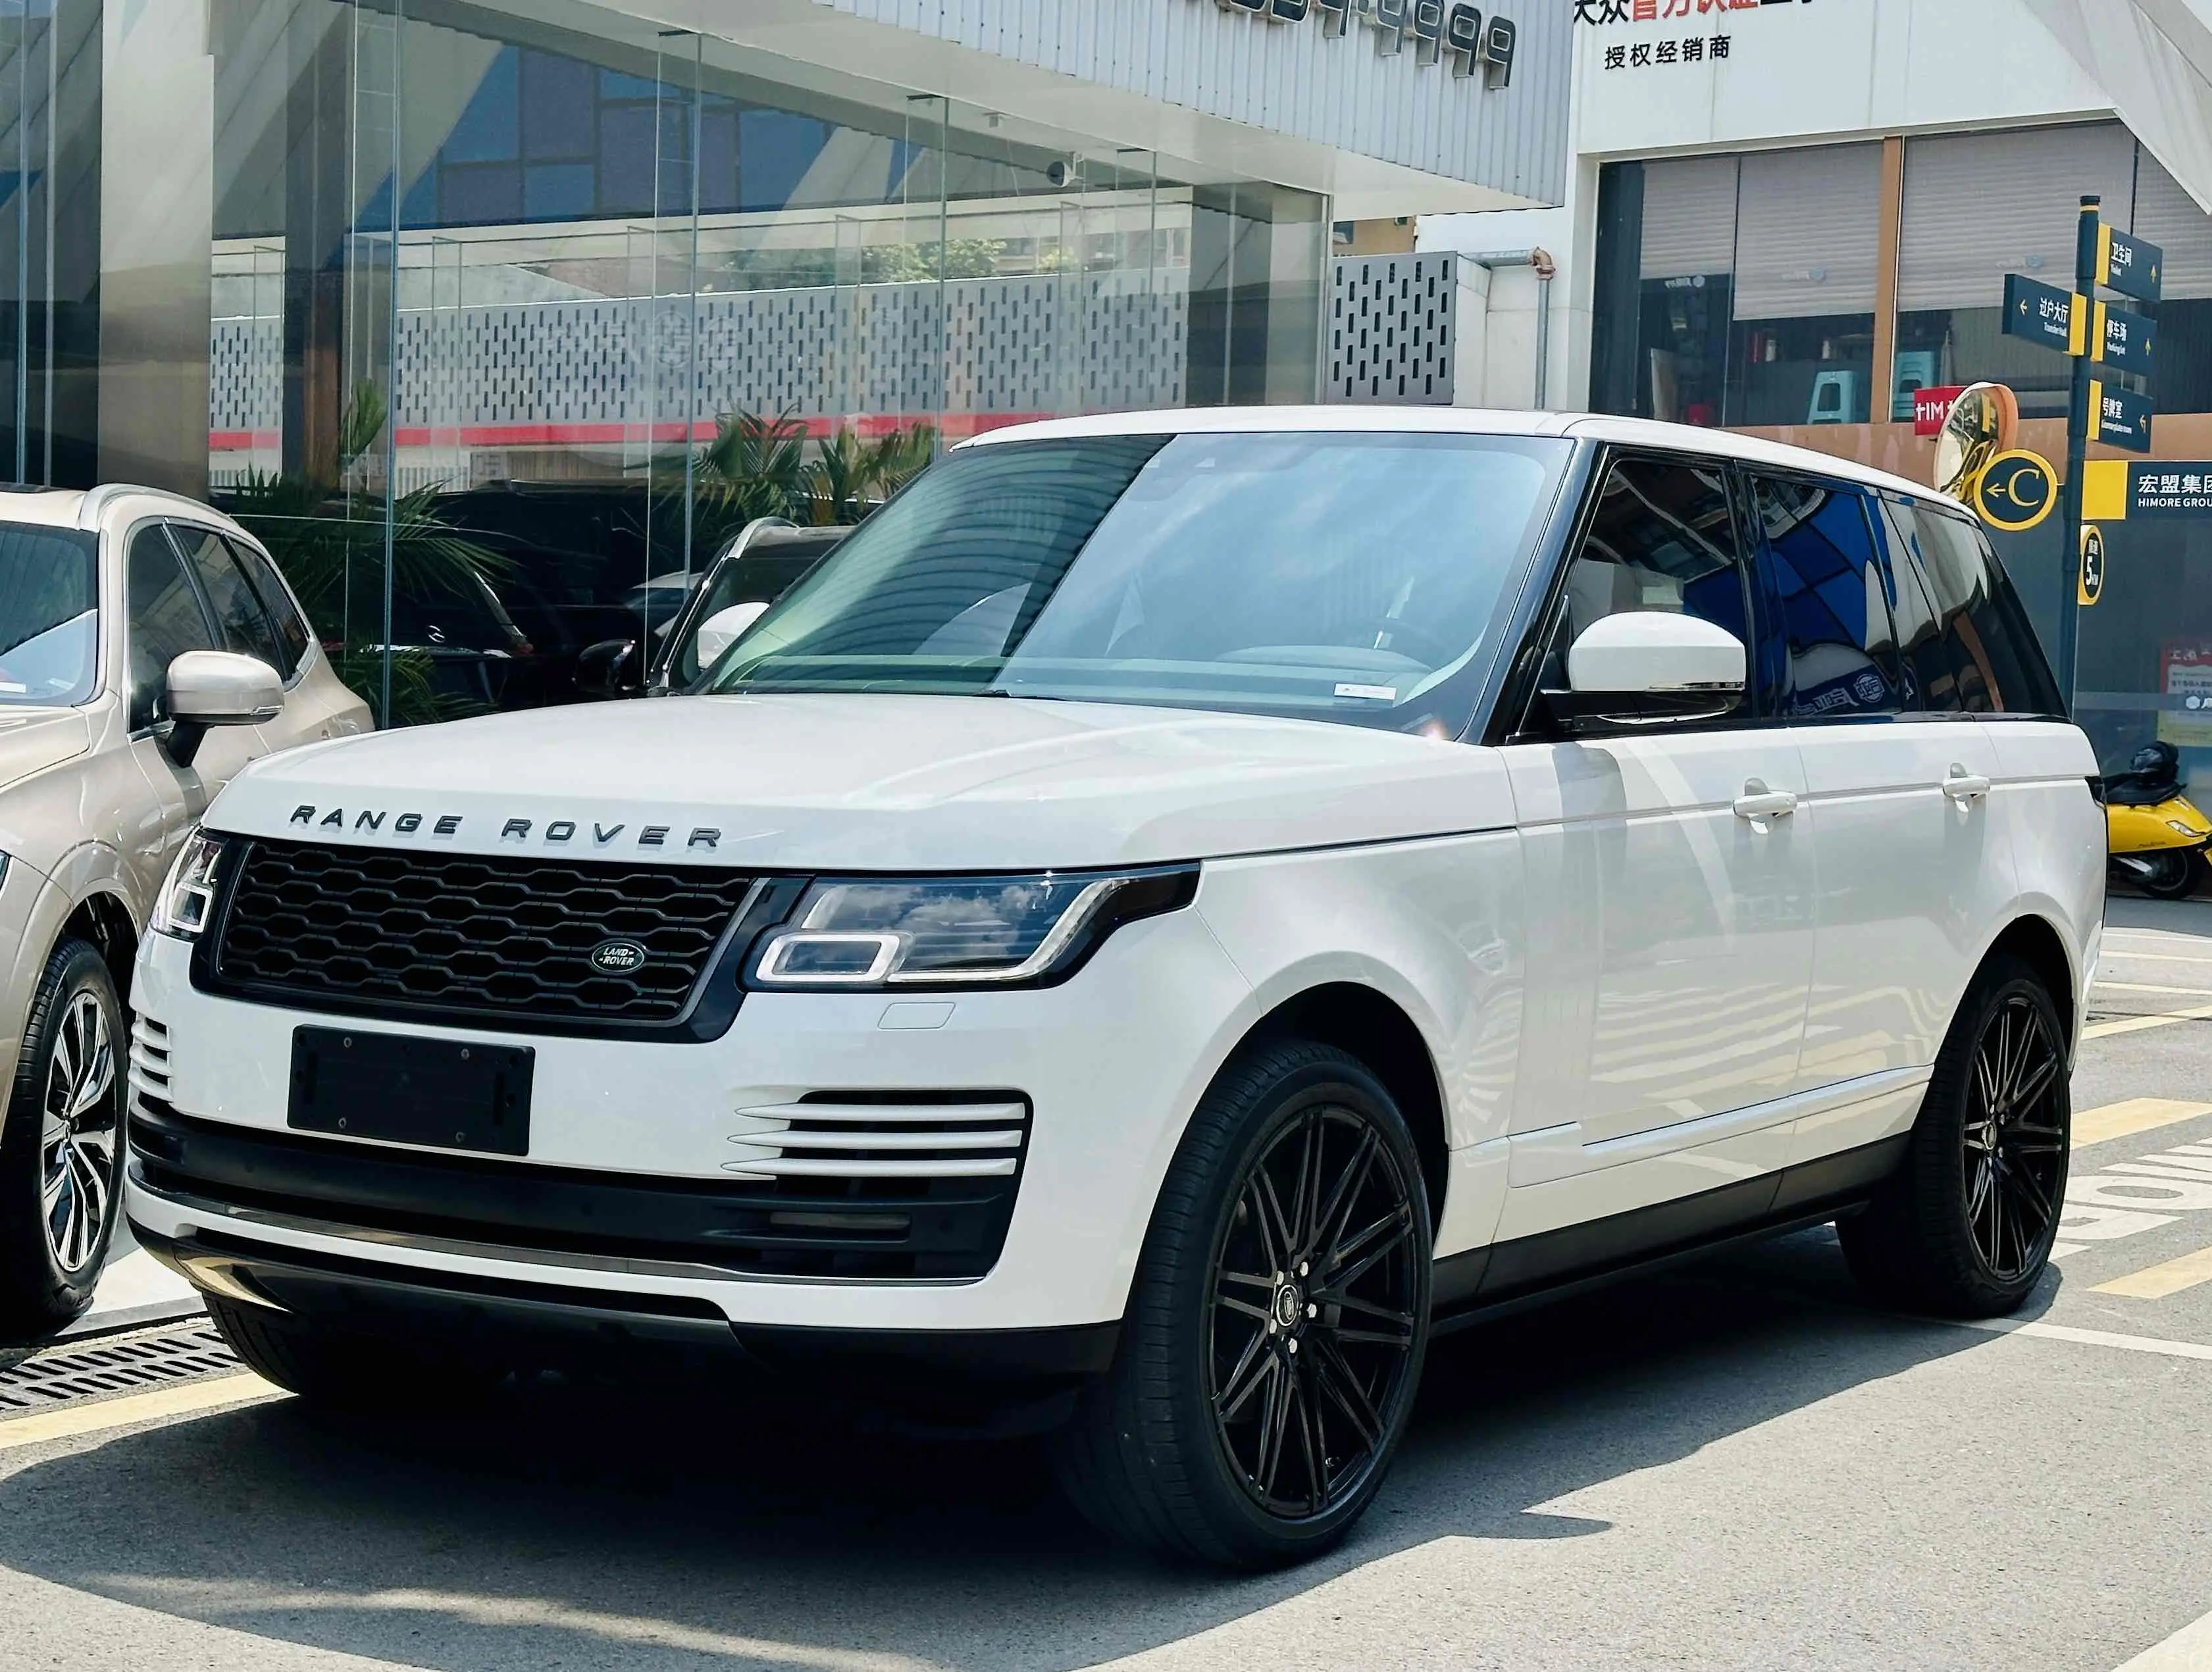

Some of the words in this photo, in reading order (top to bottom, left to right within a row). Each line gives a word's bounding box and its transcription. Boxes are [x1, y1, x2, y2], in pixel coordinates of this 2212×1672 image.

[1605, 35, 1731, 69] 授权经销商
[2111, 242, 2132, 268] 卫生间
[2040, 297, 2069, 323] 过户大厅
[2008, 468, 2040, 507] C
[2138, 498, 2181, 507] HIMORE
[290, 805, 463, 835] RANGE
[501, 819, 721, 848] ROVER
